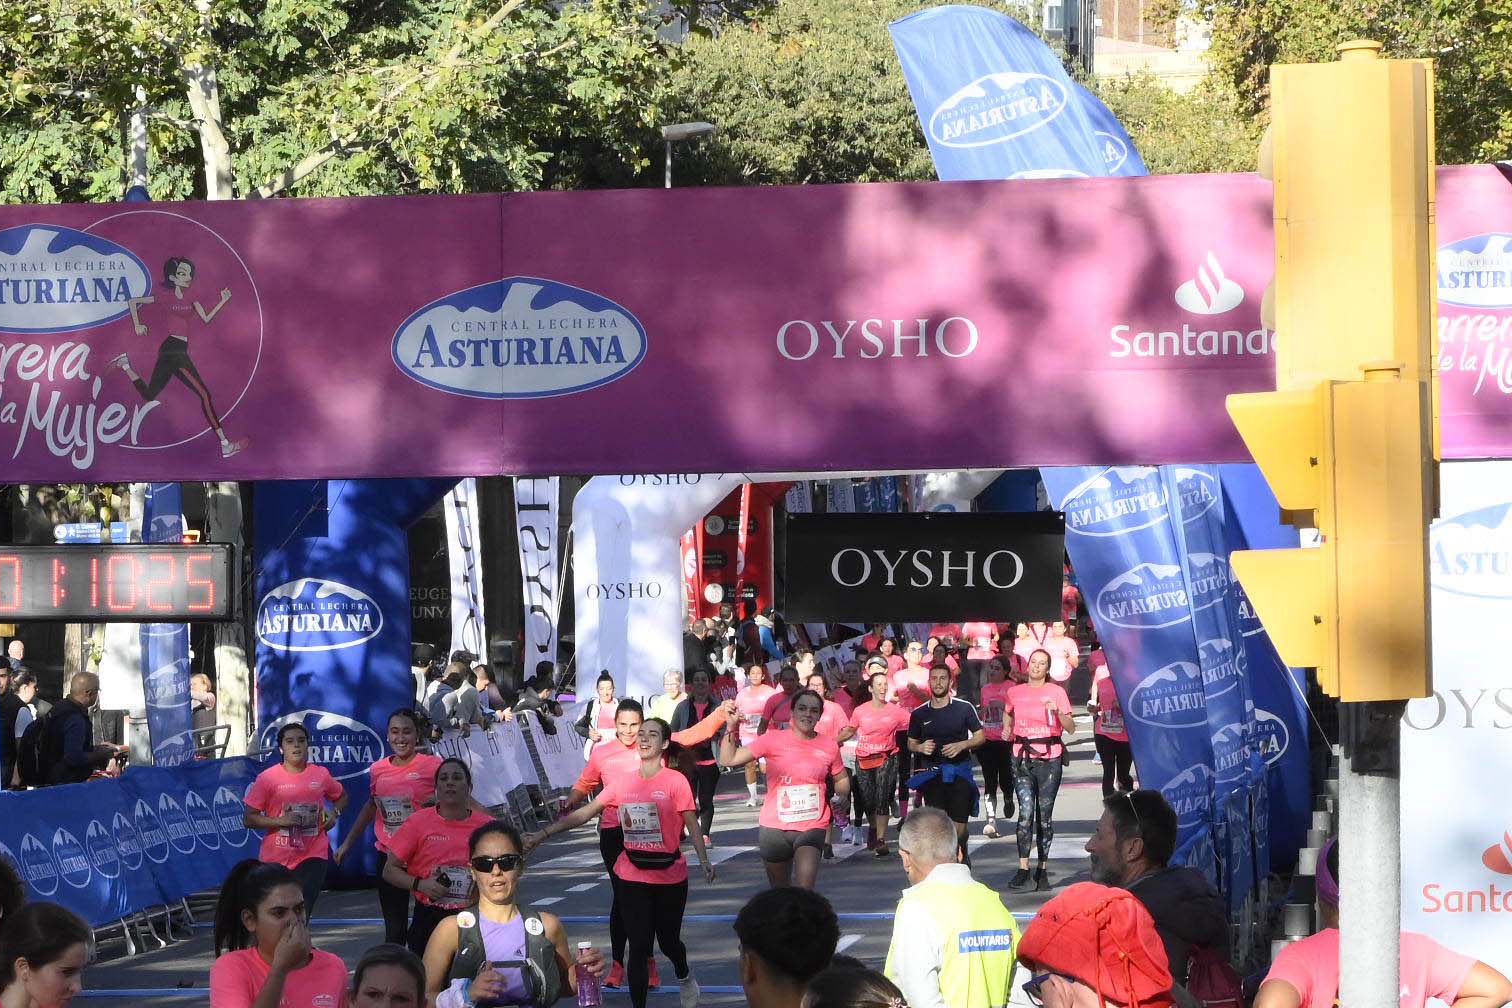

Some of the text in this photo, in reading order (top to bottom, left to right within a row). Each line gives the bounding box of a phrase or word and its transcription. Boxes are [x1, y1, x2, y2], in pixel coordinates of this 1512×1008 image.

[54, 260, 126, 272] LECHERA
[451, 318, 618, 331] CENTRAL LECHERA
[776, 316, 979, 360] OYSHO
[412, 324, 628, 369] ASTURIANA
[13, 376, 161, 470] Mujer
[831, 548, 1026, 590] OYSHO
[586, 581, 662, 600] OYSHO
[261, 607, 373, 636] ASTURIANA
[273, 602, 369, 612] CENTRAL LECHERA
[1402, 687, 1512, 730] OYS
[307, 745, 375, 763] RIANA
